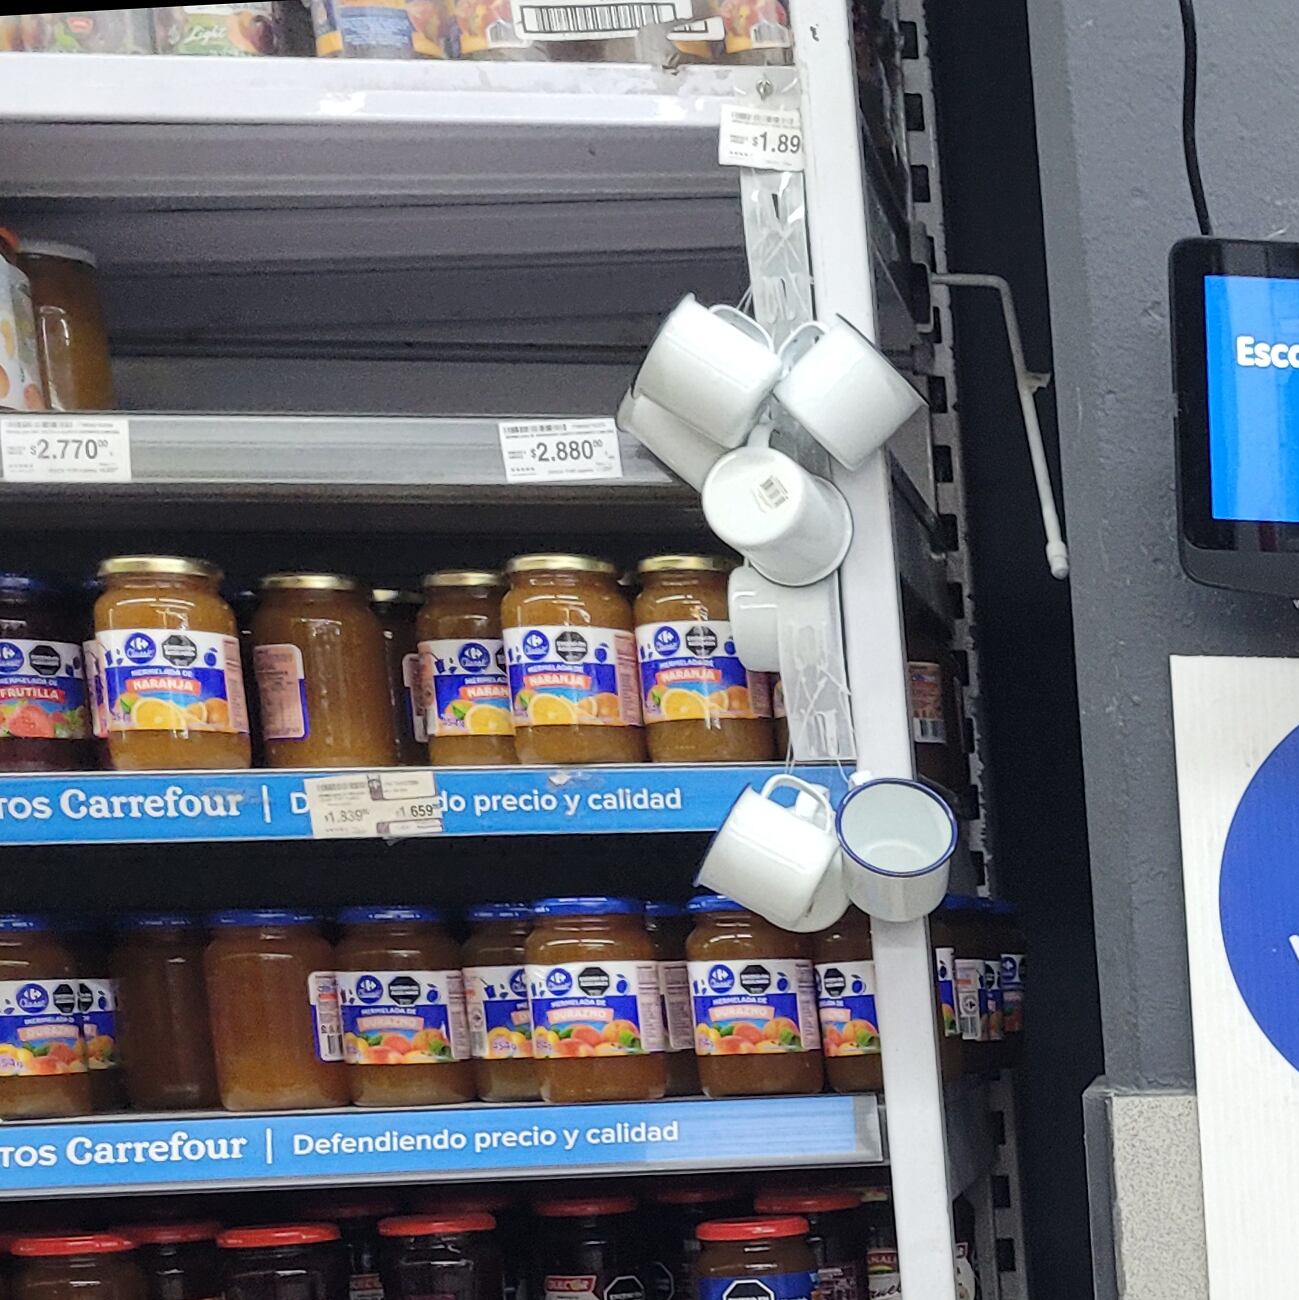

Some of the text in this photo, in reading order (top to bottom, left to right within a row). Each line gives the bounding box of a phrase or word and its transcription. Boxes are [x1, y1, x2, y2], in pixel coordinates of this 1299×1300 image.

[662, 669, 714, 681] NARANJA
[133, 679, 193, 691] NARANJA
[530, 676, 584, 688] NARANJA
[60, 786, 243, 819] Carrefour
[475, 790, 557, 814] precio
[566, 794, 582, 815] y
[588, 788, 681, 811] calidad
[67, 1132, 246, 1163] Carrefour
[294, 1130, 465, 1156] Defendiendo
[476, 1129, 557, 1152] precio
[564, 1130, 580, 1150] y
[586, 1121, 678, 1144] calidad
